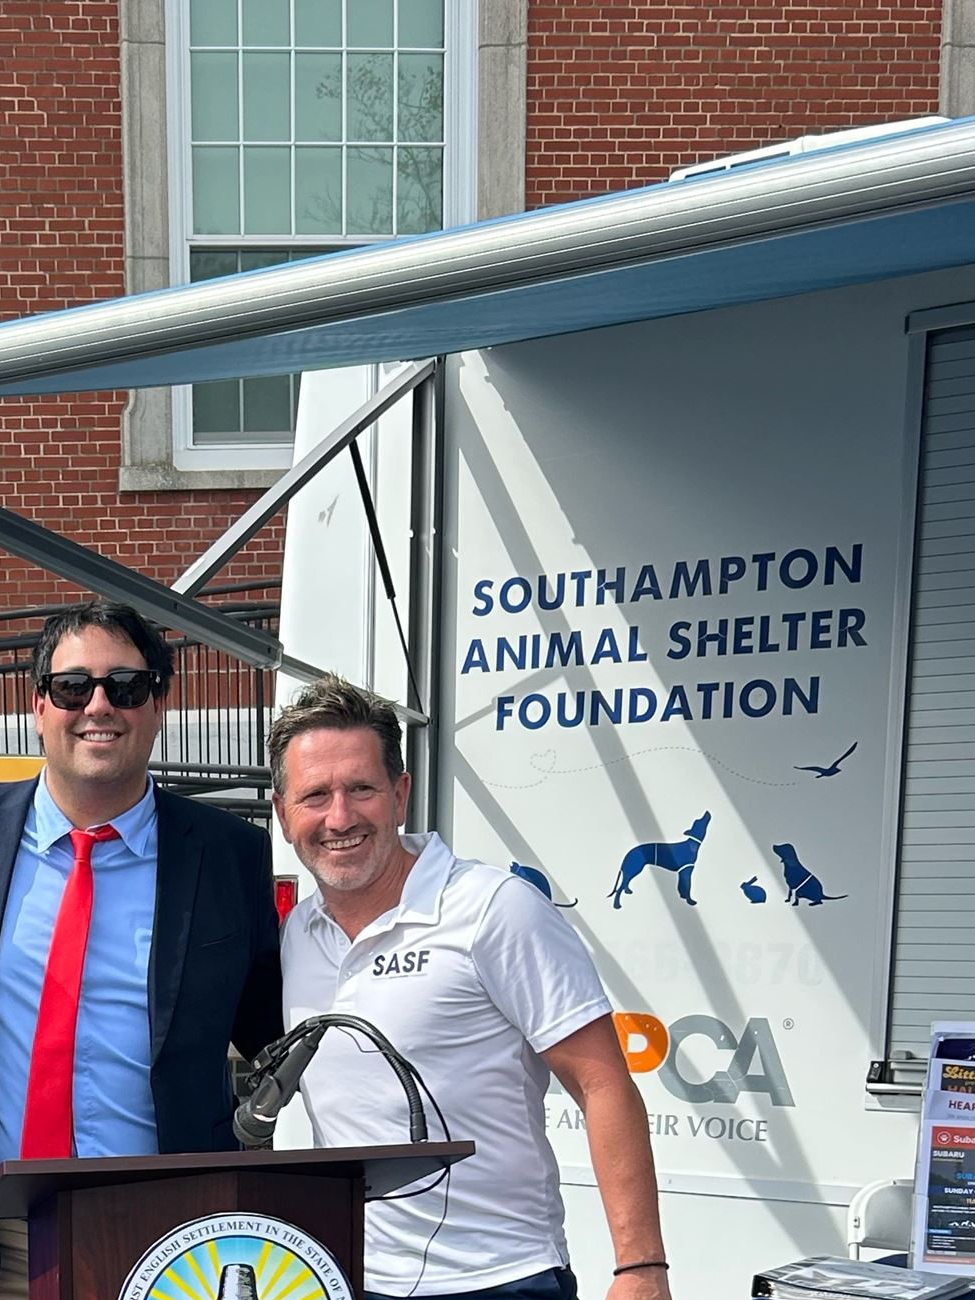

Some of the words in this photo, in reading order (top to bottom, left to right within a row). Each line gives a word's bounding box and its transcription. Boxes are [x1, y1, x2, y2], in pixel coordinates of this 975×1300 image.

[472, 543, 863, 617] SOUTHAMPTON
[461, 624, 649, 674] ANIMAL
[666, 607, 868, 660] SHELTER
[495, 676, 820, 731] FOUNDATION
[373, 950, 430, 976] SASF
[613, 1011, 795, 1107] PCA
[942, 1065, 975, 1080] Litt
[557, 1108, 586, 1130] AR
[648, 1113, 679, 1136] EIR
[687, 1116, 768, 1142] VOICE
[953, 1135, 975, 1144] Suba
[933, 1150, 964, 1159] SUBARU
[944, 1187, 973, 1195] SUNDAY
[140, 1239, 182, 1282] ENGLISH
[182, 1221, 263, 1243] SETTLEMENT
[265, 1224, 280, 1236] IN
[282, 1230, 306, 1249] THE
[305, 1246, 334, 1277] STATE
[328, 1278, 343, 1292] OF
